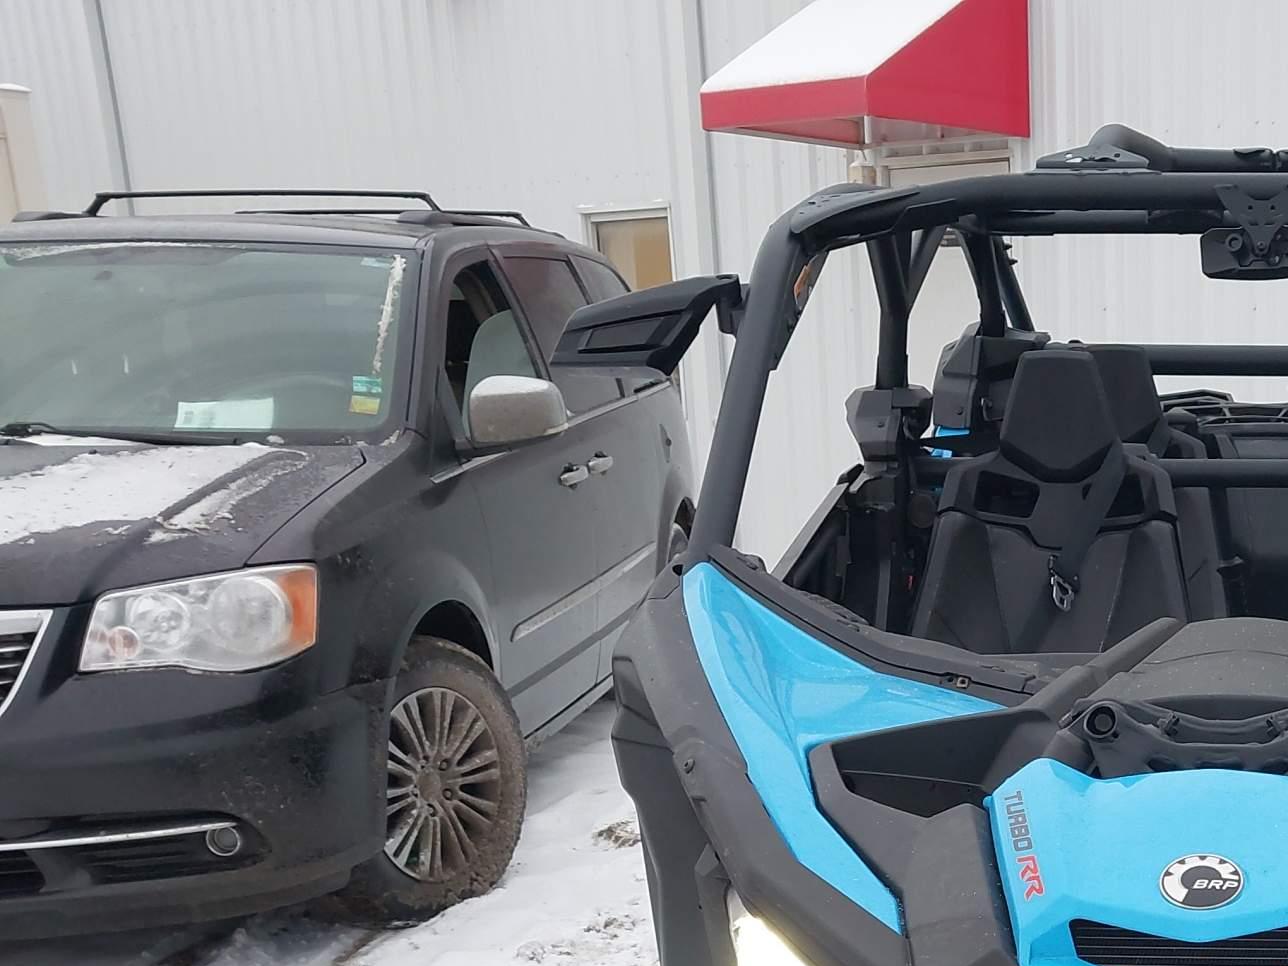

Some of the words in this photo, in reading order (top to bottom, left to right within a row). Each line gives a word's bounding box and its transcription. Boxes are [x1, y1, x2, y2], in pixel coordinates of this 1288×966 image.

[1004, 790, 1033, 852] TURBO
[1016, 855, 1045, 901] RR
[1192, 879, 1239, 890] BRP
